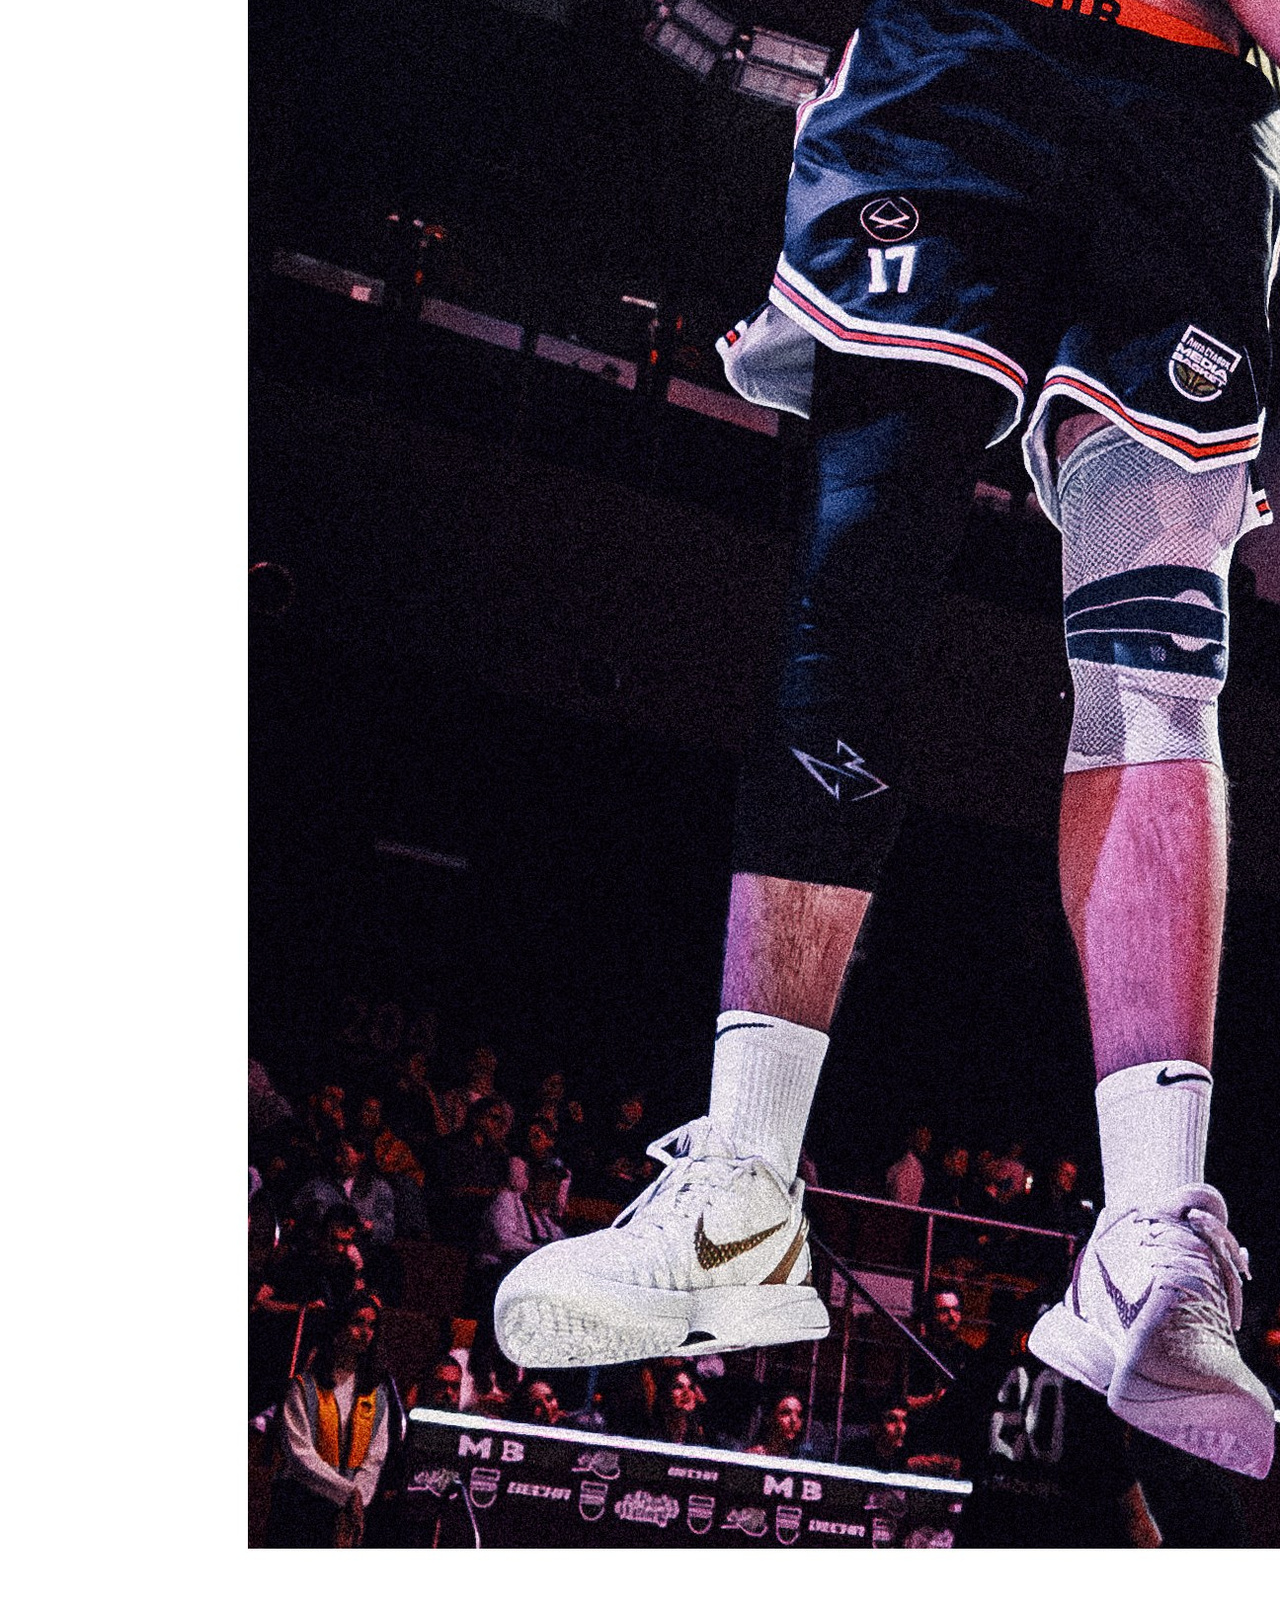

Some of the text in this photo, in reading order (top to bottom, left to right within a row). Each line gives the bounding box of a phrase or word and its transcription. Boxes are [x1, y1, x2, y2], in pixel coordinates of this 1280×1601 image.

[868, 245, 917, 294] 17
[1171, 351, 1228, 388] BASKET
[1175, 342, 1228, 384] MEDIA
